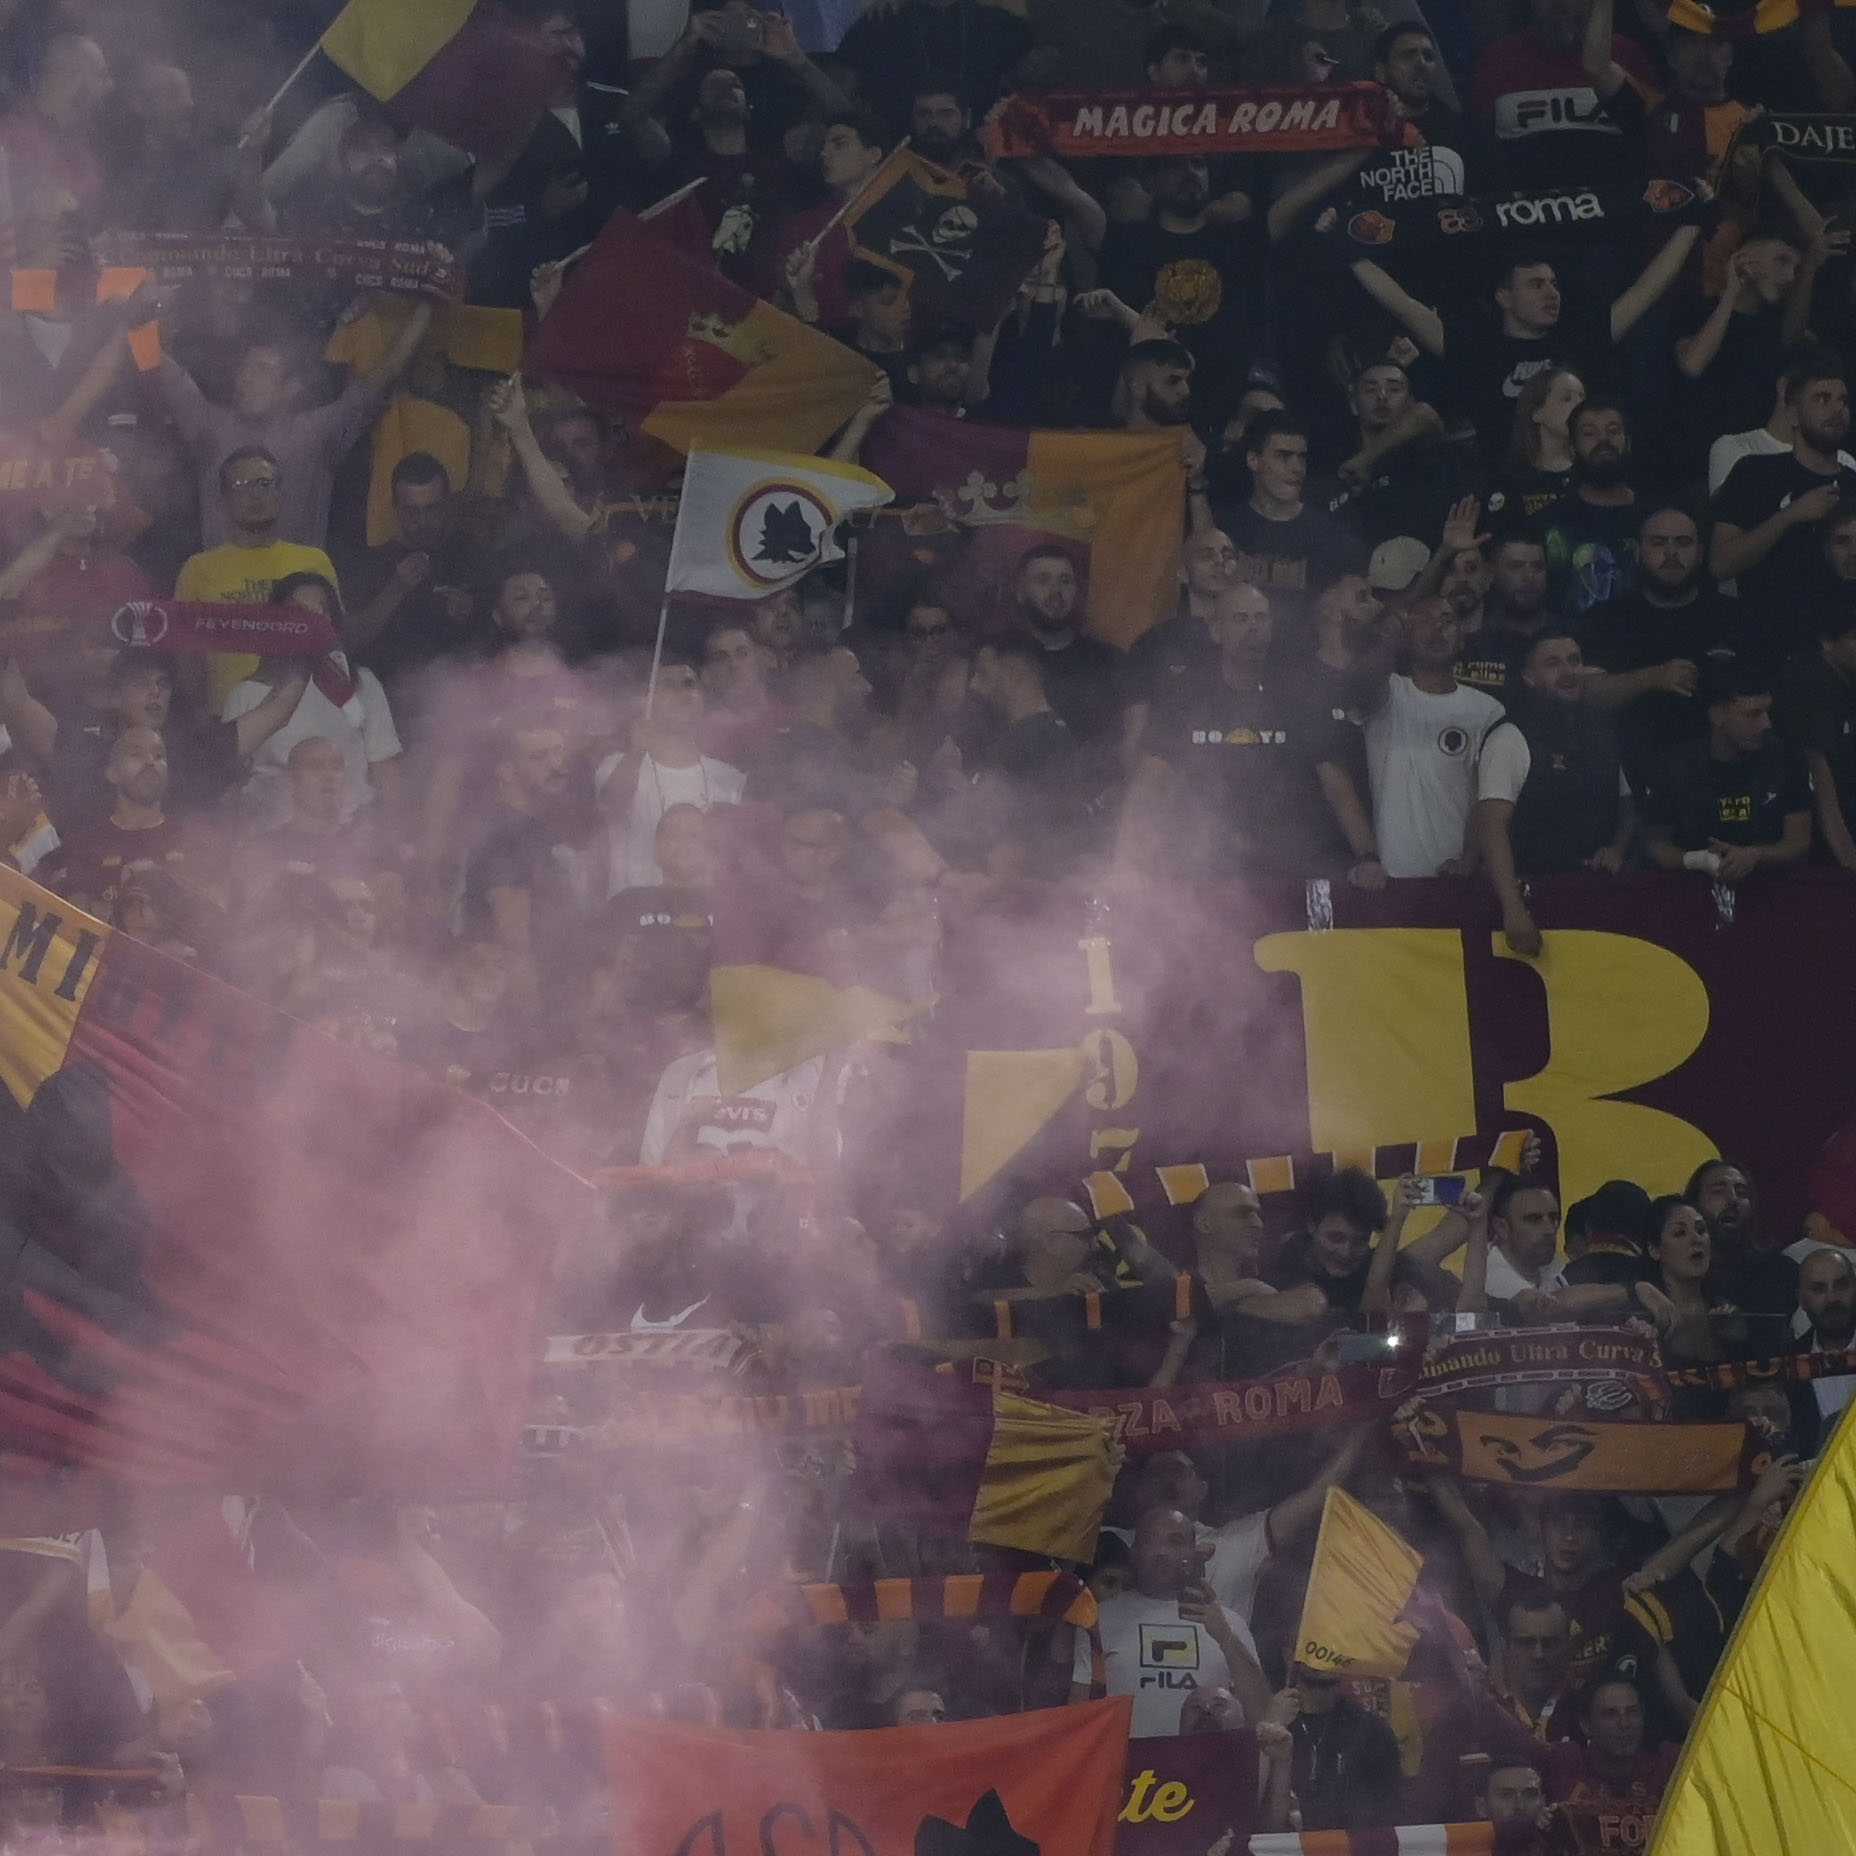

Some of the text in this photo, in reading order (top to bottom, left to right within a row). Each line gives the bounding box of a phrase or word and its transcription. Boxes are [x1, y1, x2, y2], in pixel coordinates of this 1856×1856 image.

[1072, 99, 1341, 138] MAGICA ROMA
[1771, 120, 1856, 152] DAJE
[1390, 148, 1432, 169] THE
[1360, 164, 1434, 189] NORTH
[1383, 182, 1434, 202] FACE
[1496, 192, 1606, 228] roma
[1213, 1377, 1345, 1427] ROMA
[1139, 1672, 1198, 1690] FILA
